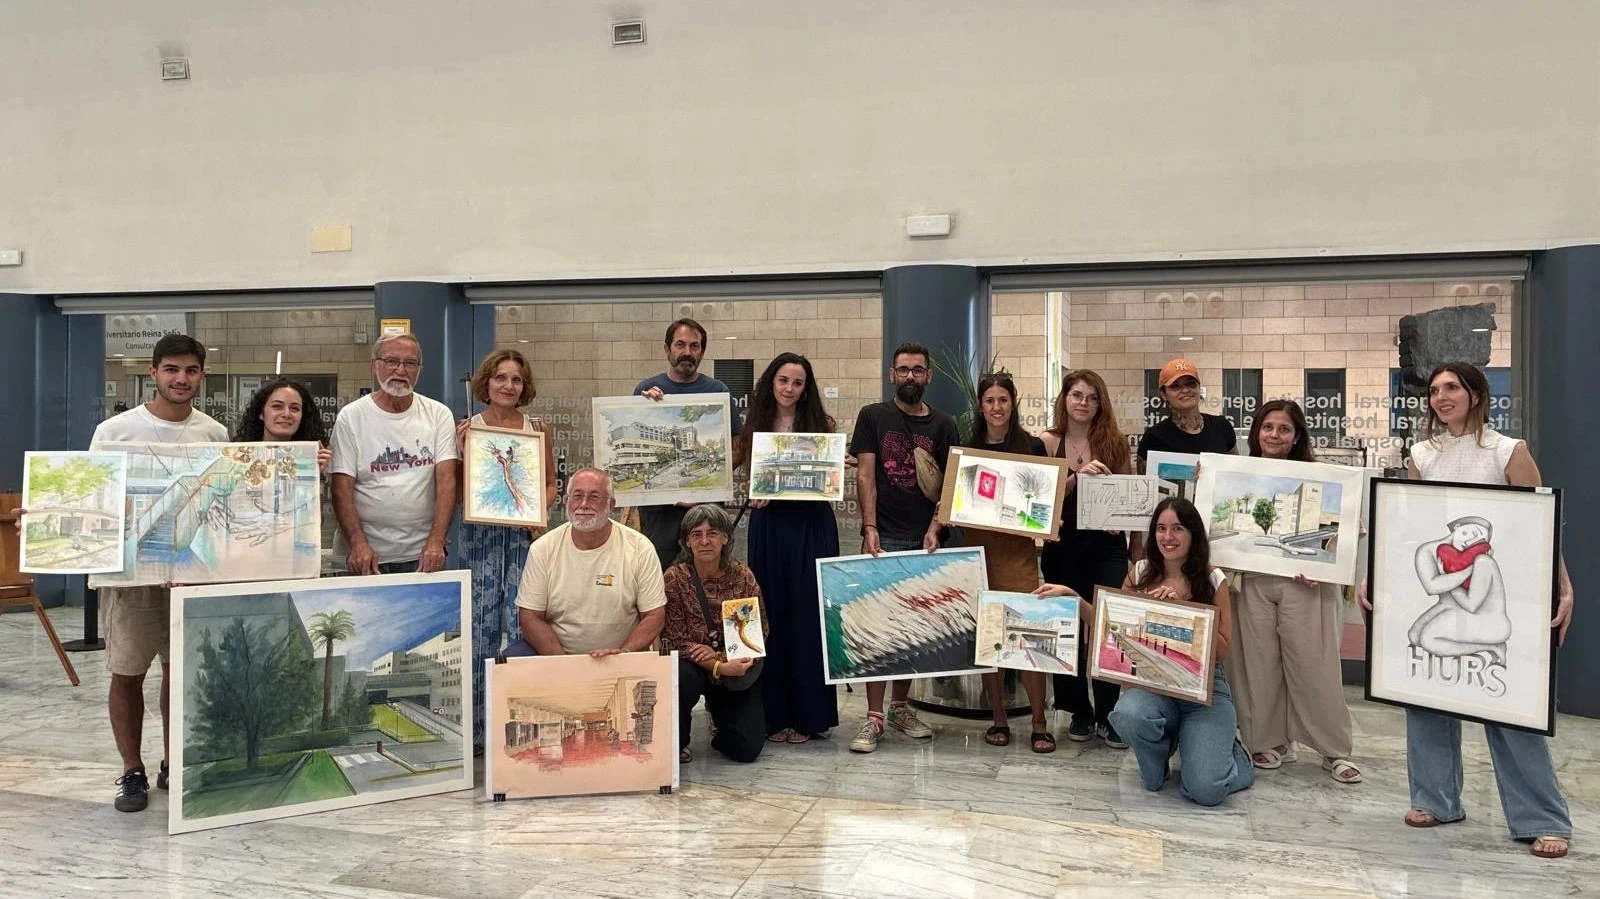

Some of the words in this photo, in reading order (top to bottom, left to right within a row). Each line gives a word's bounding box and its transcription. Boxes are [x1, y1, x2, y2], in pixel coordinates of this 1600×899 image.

[142, 329, 162, 338] Reina
[370, 464, 400, 473] New
[406, 456, 434, 469] York
[1406, 644, 1508, 698] HURS
